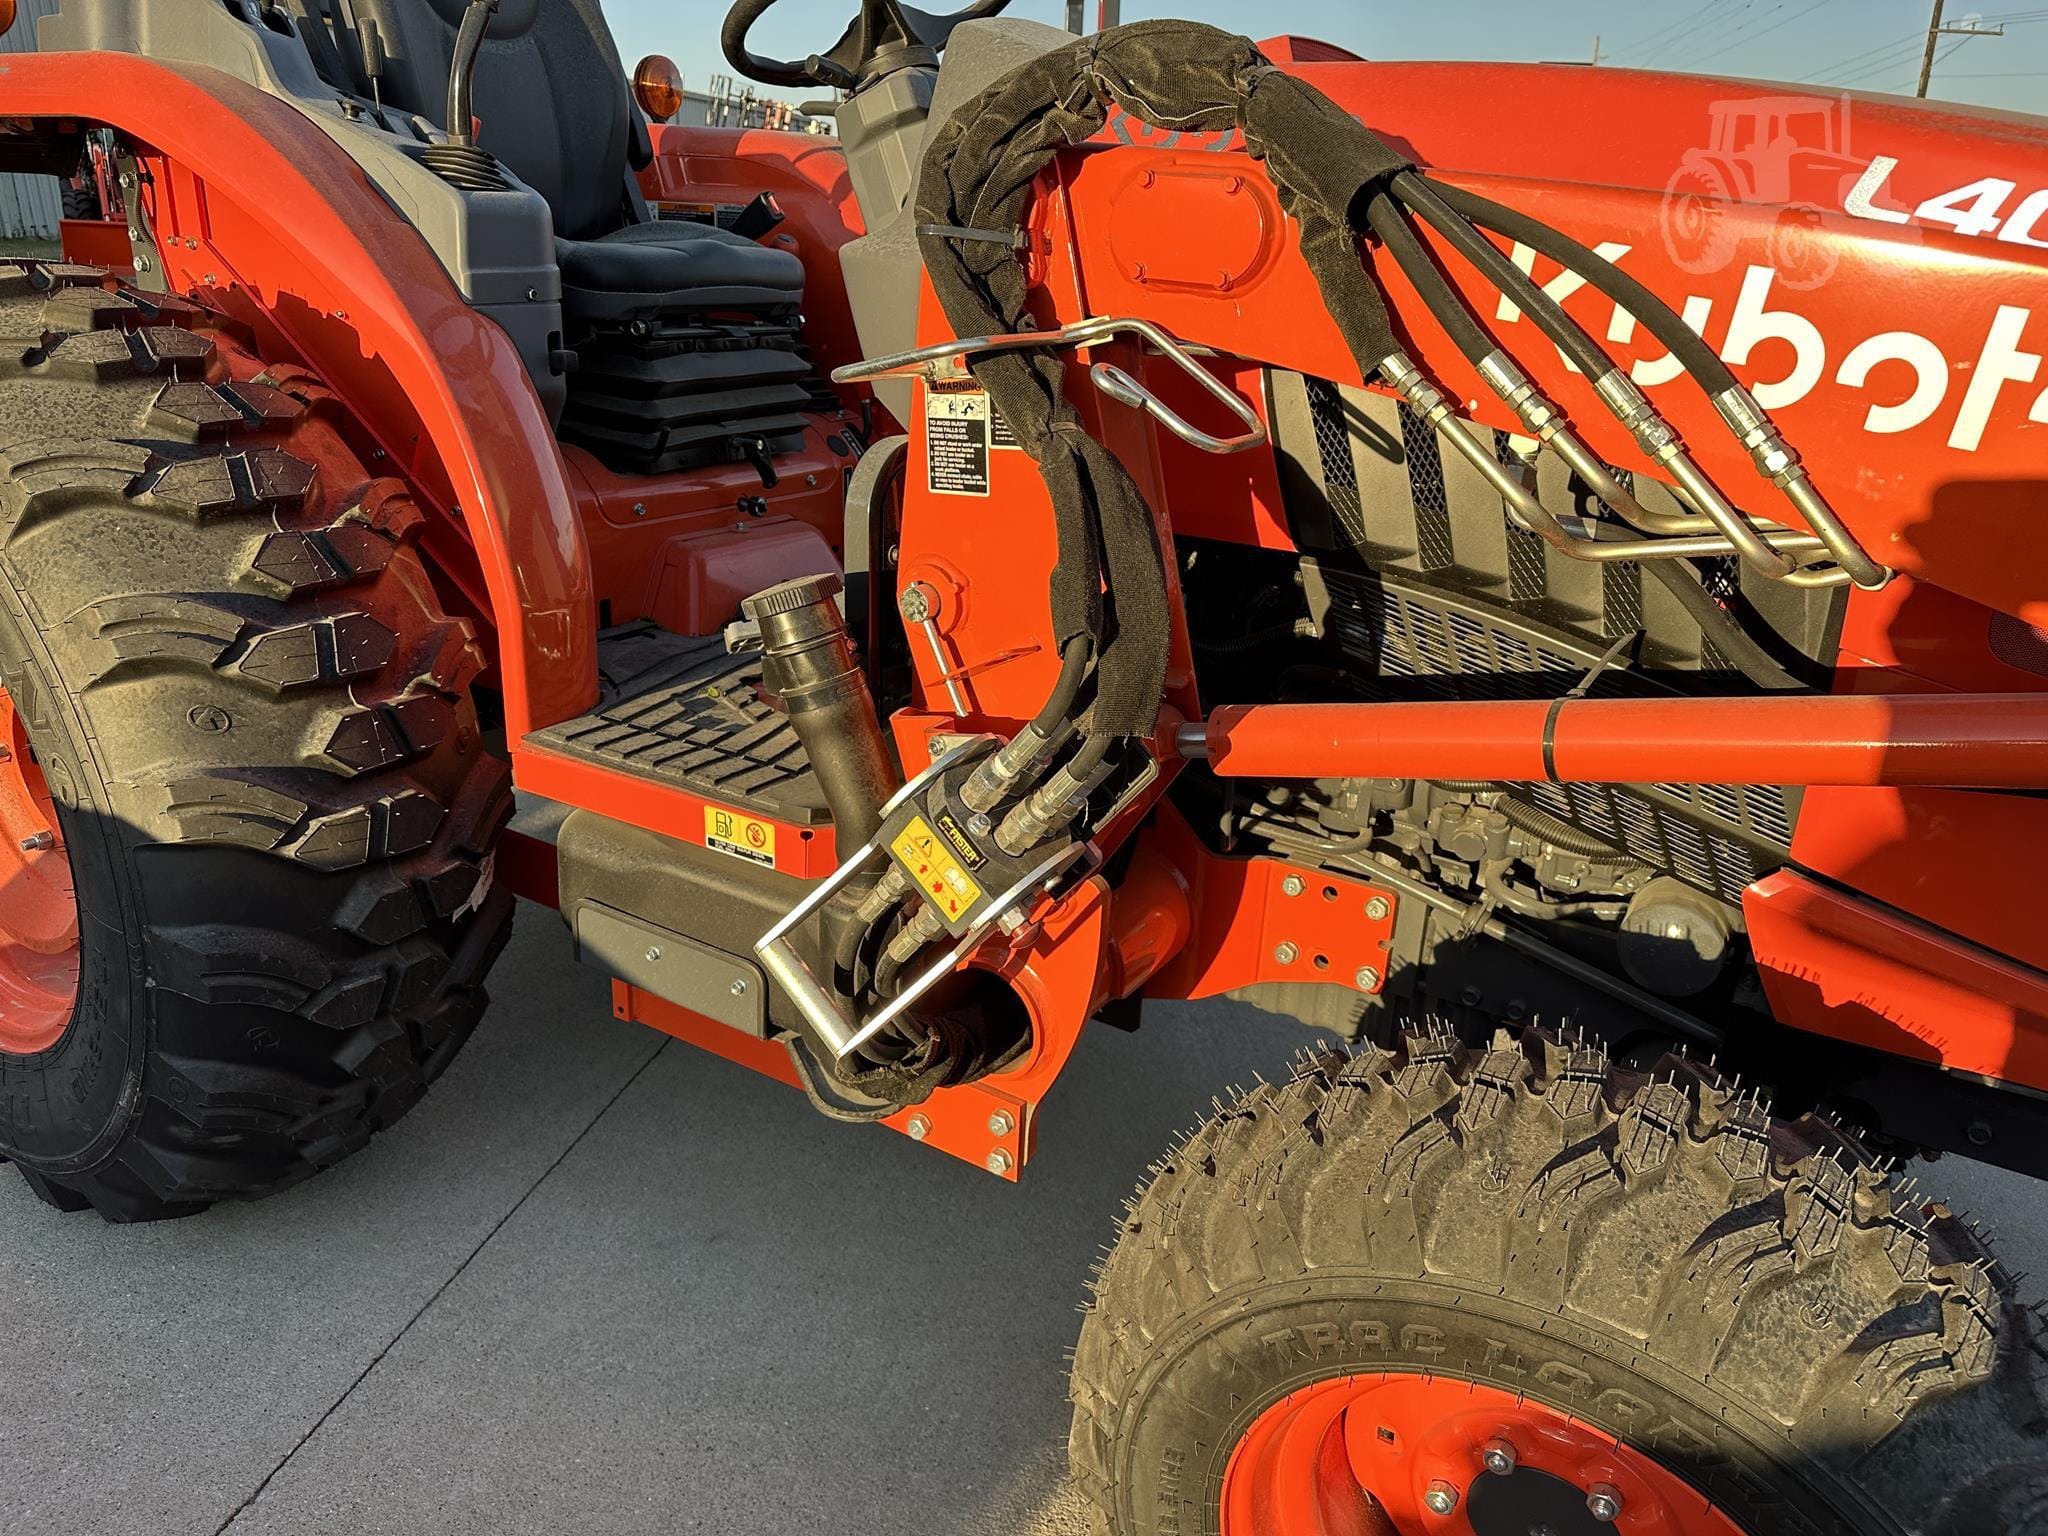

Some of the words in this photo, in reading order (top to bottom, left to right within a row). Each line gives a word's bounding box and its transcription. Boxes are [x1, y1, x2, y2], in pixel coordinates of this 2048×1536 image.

[1495, 241, 2048, 451] Kubot
[938, 380, 981, 391] WARNING
[1261, 1320, 1447, 1364] TRAC
